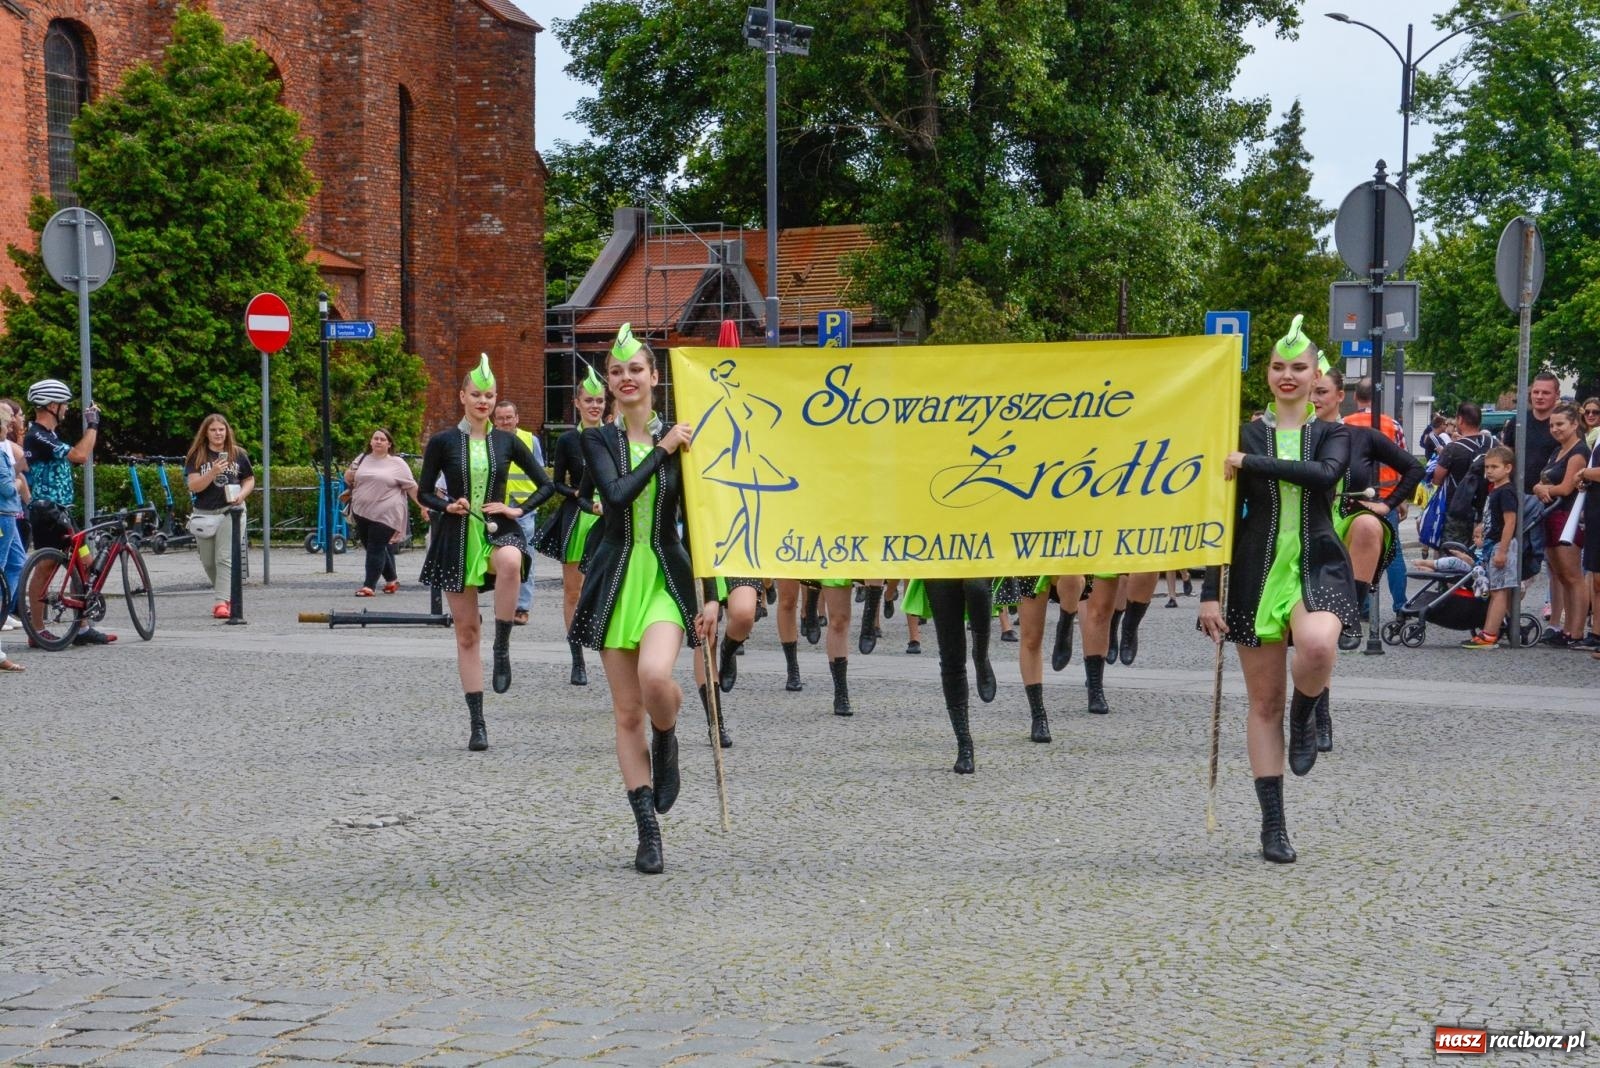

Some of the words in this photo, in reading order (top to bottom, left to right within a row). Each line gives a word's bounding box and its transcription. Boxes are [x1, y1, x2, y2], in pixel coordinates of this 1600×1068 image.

[826, 314, 841, 334] P
[802, 363, 1134, 436] Stowarzyszenie
[929, 430, 1205, 508] Źródło
[775, 528, 869, 569] ŚLĄSK
[880, 532, 995, 562] KRAINA
[1010, 529, 1103, 560] WIELU
[1113, 521, 1225, 556] KULTUR
